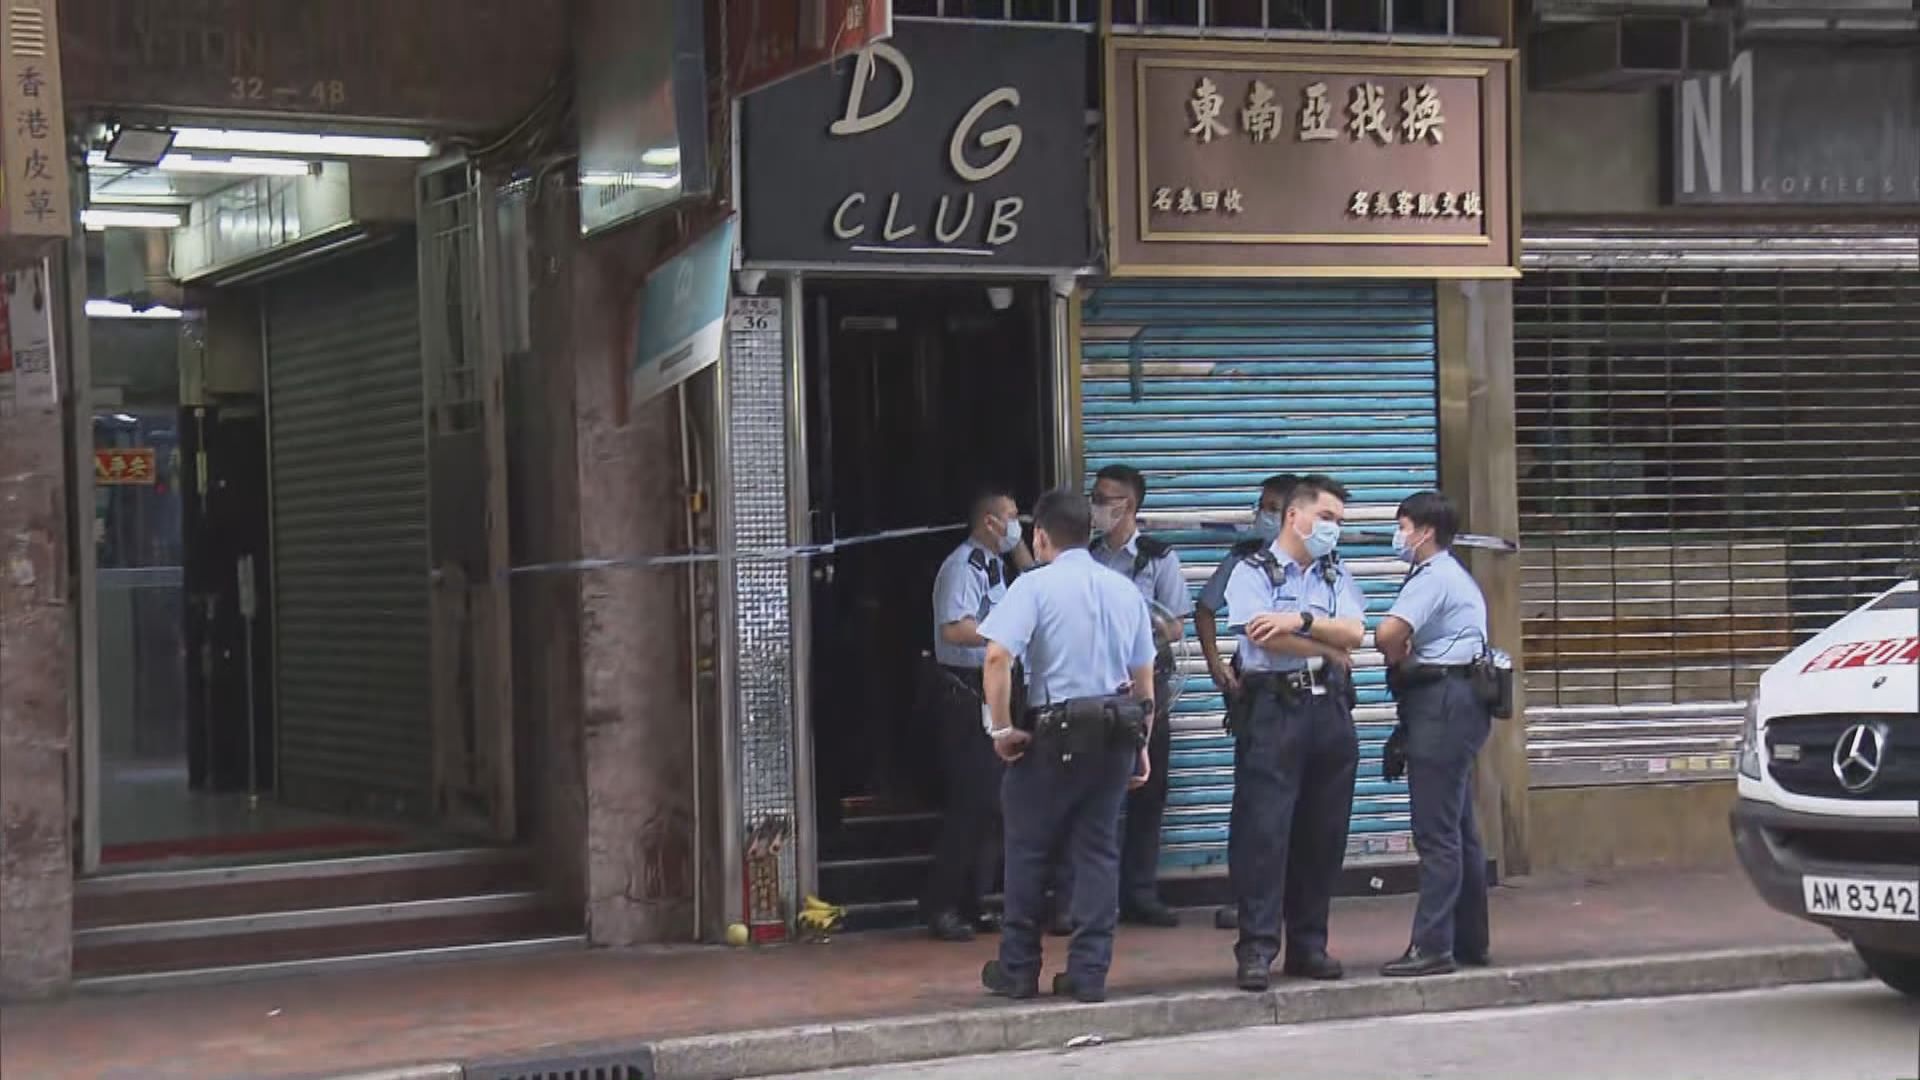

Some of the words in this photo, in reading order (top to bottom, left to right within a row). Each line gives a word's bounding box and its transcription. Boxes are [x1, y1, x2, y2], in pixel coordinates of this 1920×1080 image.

[230, 77, 264, 99] 32
[1188, 77, 1446, 144] 東南亞找換
[1682, 50, 1754, 194] N1
[17, 66, 57, 222] 香港皮草
[833, 192, 1023, 245] CLUB
[743, 316, 768, 330] 36
[1832, 639, 1918, 669] POL
[1813, 882, 1841, 911] AM
[1846, 884, 1917, 914] 8342
